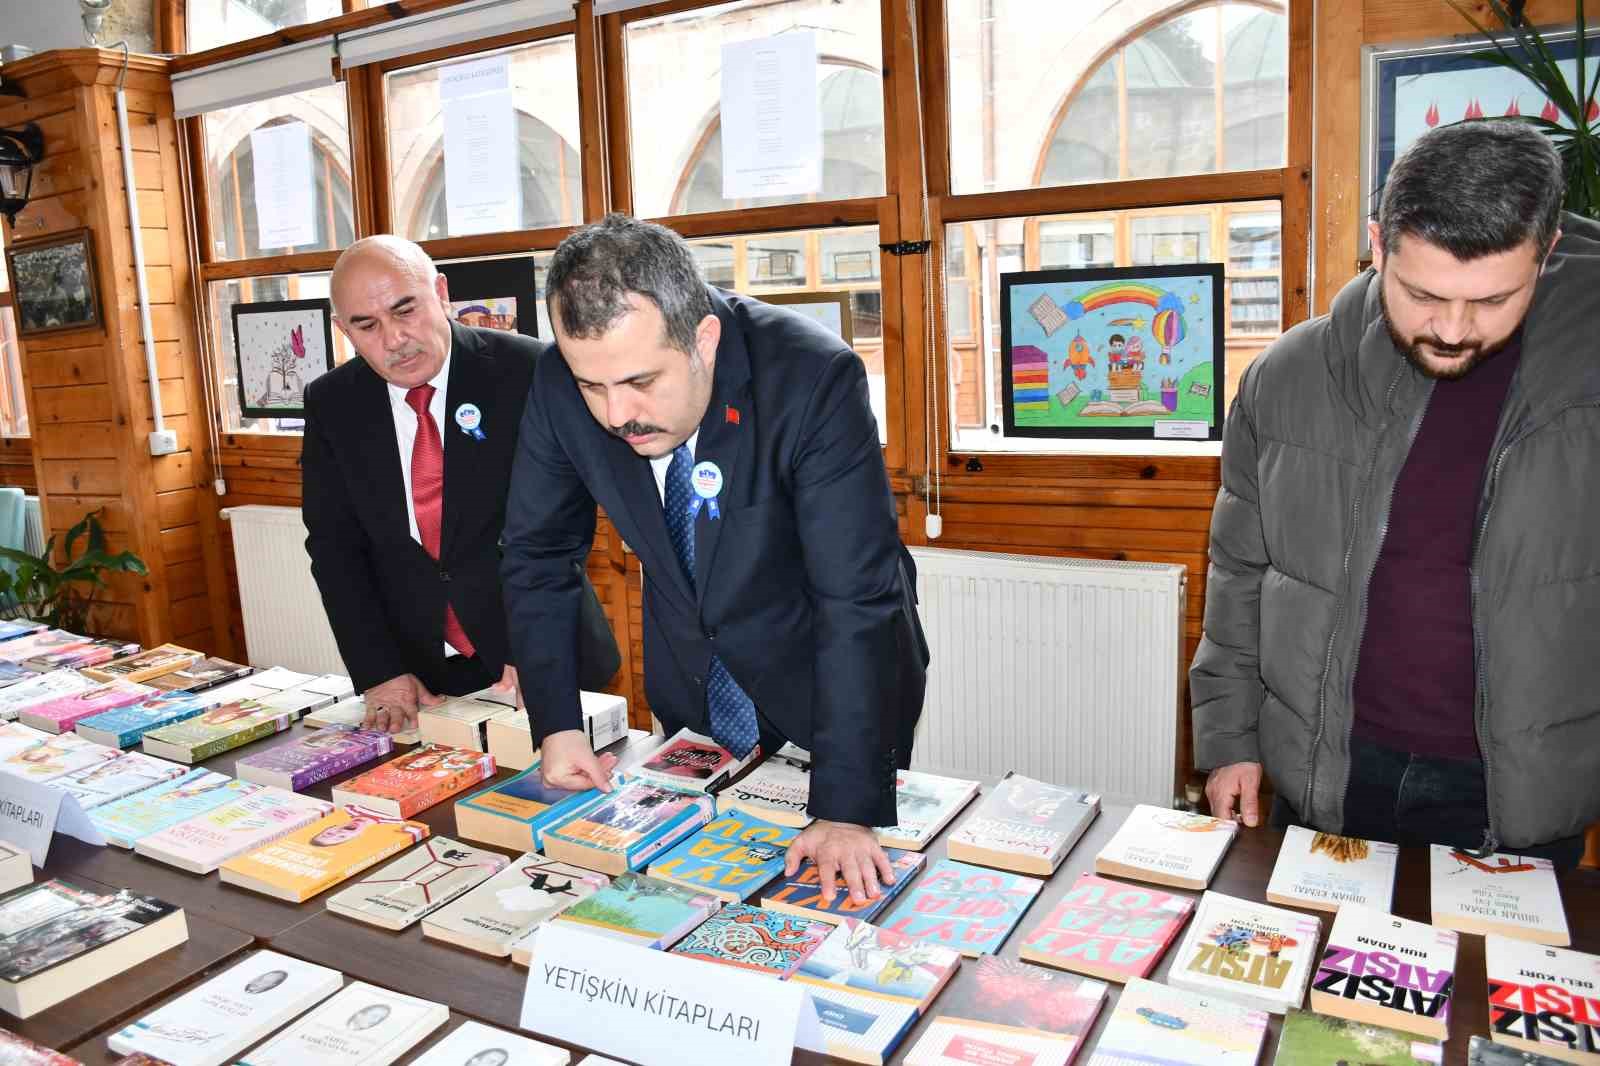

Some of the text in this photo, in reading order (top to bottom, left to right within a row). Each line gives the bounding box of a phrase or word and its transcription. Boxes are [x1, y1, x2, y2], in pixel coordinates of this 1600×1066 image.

[656, 857, 766, 886] AYT
[1024, 933, 1158, 965] AYT
[1186, 943, 1294, 990] ATSIZ
[1322, 944, 1453, 995] ATSIZ
[1356, 935, 1428, 959] RUH ADAM
[1312, 968, 1449, 1018] ATSIZ
[1518, 968, 1556, 982] KURT
[543, 962, 639, 1009] YETİŞKİN
[643, 988, 761, 1042] KİTAPLARI
[1493, 1005, 1600, 1055] TSIZ
